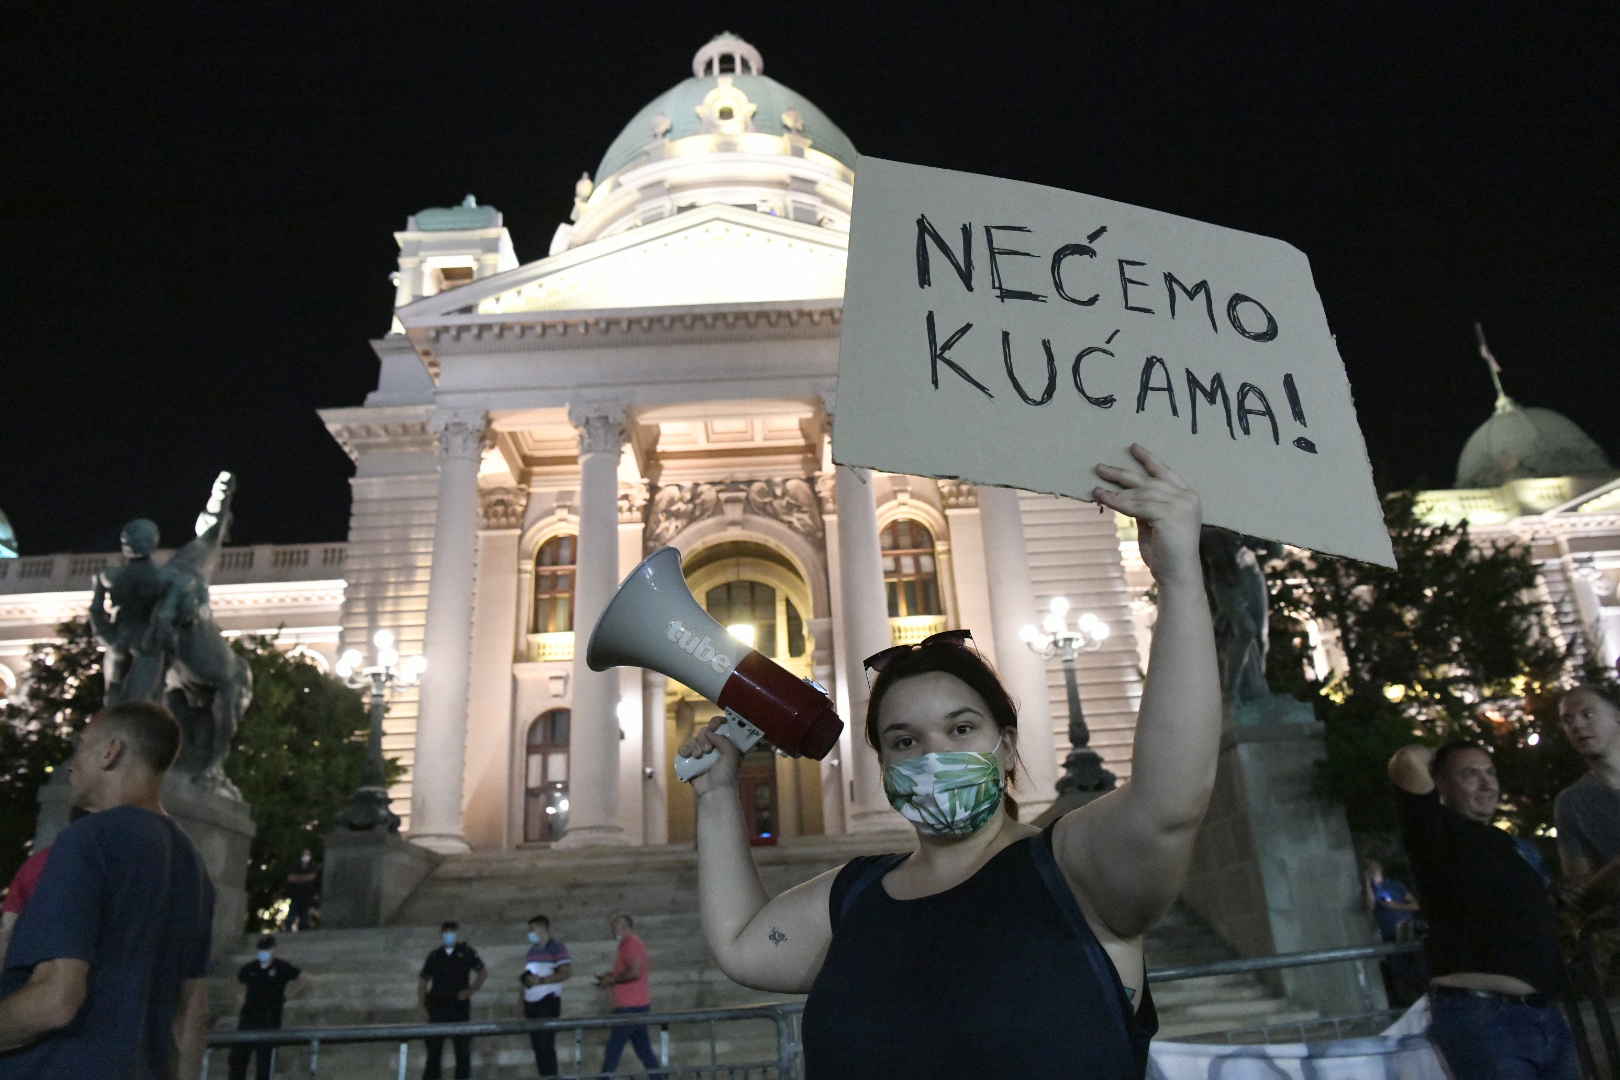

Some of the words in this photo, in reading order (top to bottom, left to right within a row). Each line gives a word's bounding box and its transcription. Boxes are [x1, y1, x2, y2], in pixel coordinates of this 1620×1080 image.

[915, 213, 1278, 343] NEĆEMO
[926, 310, 1318, 455] KUĆAMA!
[664, 619, 734, 675] tube
